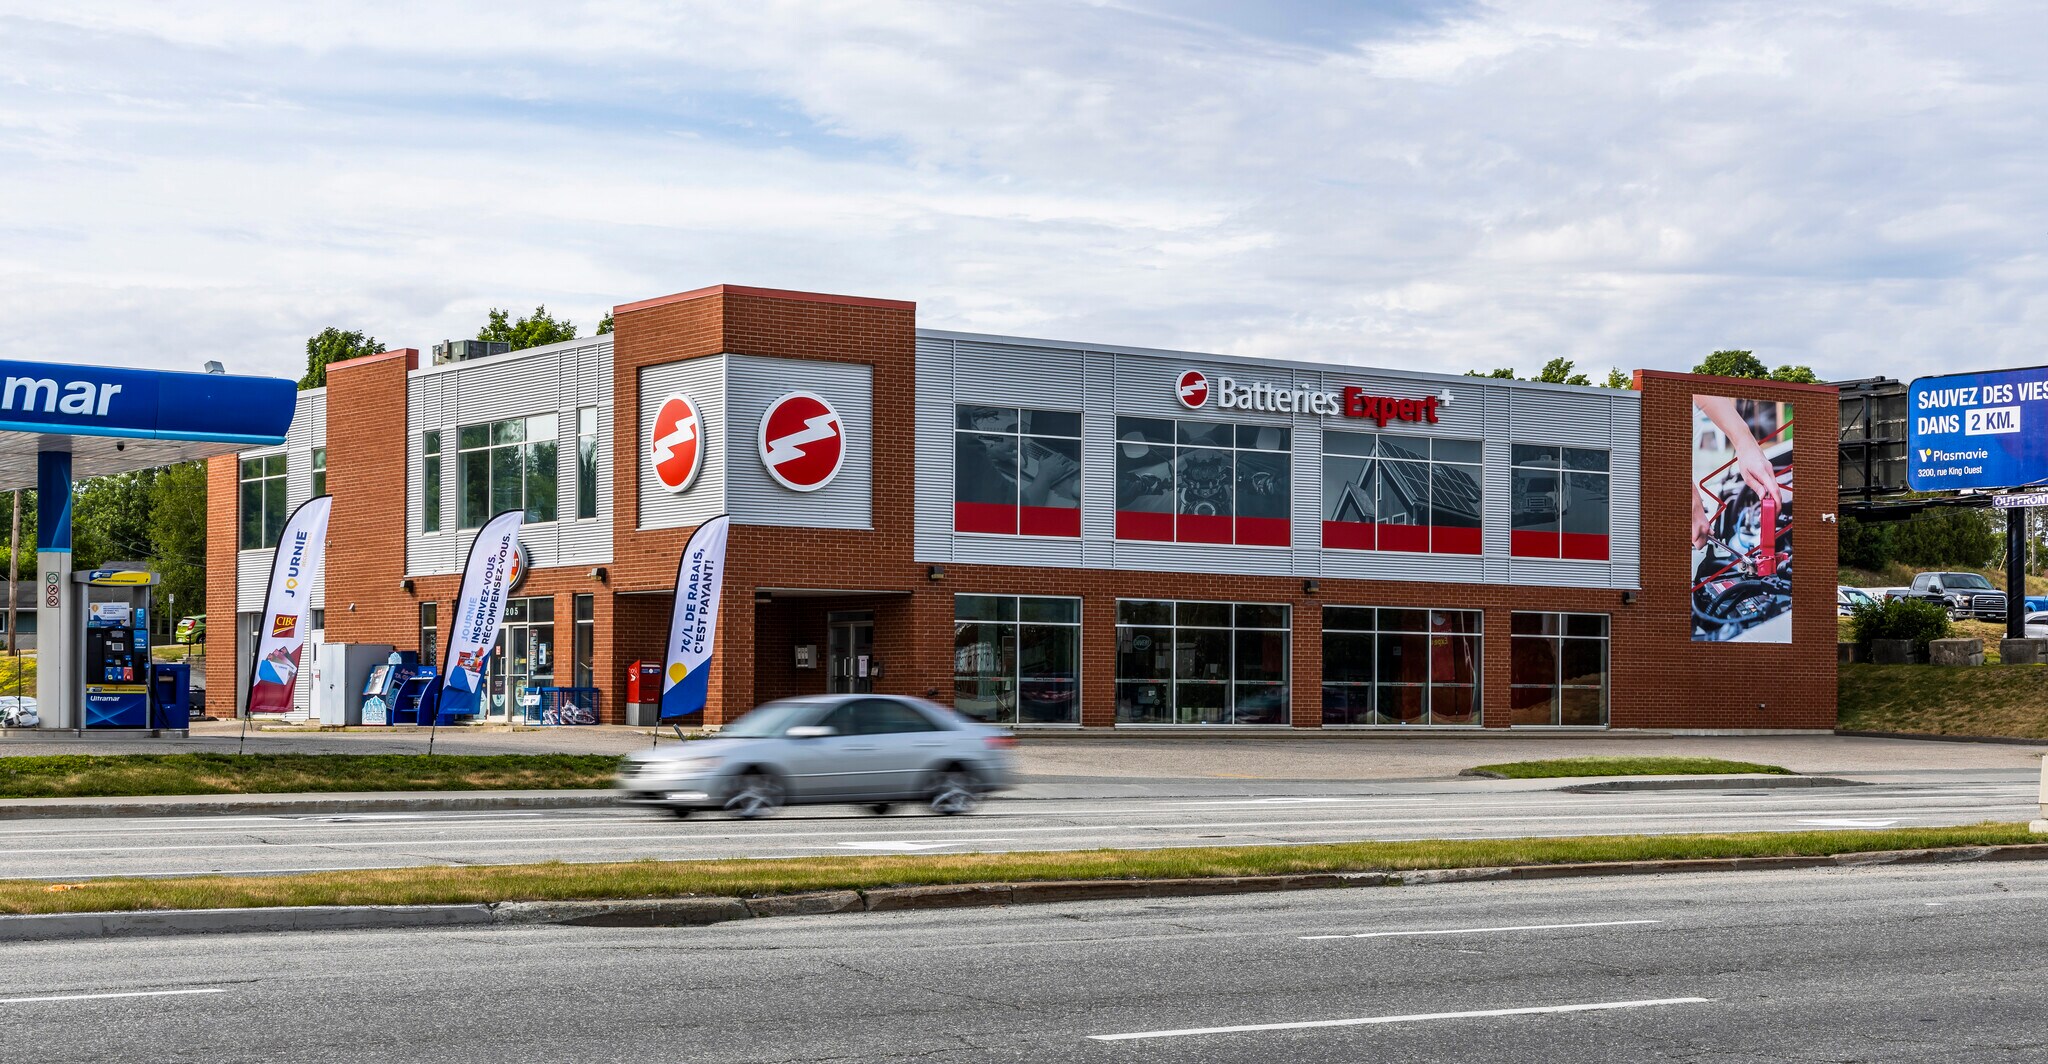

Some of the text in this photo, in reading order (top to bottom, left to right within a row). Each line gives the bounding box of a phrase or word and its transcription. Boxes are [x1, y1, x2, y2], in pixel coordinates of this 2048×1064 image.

[2, 377, 122, 415] mar
[1217, 376, 1340, 416] Batteries
[1918, 387, 1978, 409] SAUVEZ
[1982, 384, 2013, 404] DES
[1918, 411, 2015, 435] DANS 2 KM.
[1918, 468, 1936, 477] 3200,
[1948, 467, 1963, 477] King
[1963, 466, 1983, 475] Ouest
[1933, 448, 1988, 462] Plasmavie
[285, 530, 308, 598] JOURNIE
[687, 548, 706, 601] RABAIS,
[471, 554, 497, 644] INSCRIVEZ-VOUS.
[481, 533, 511, 645] RÉCOMPENSEZ-VOUS.
[694, 559, 714, 654] C'EST PAYANT!
[276, 616, 297, 626] CIBC
[685, 603, 696, 621] DE
